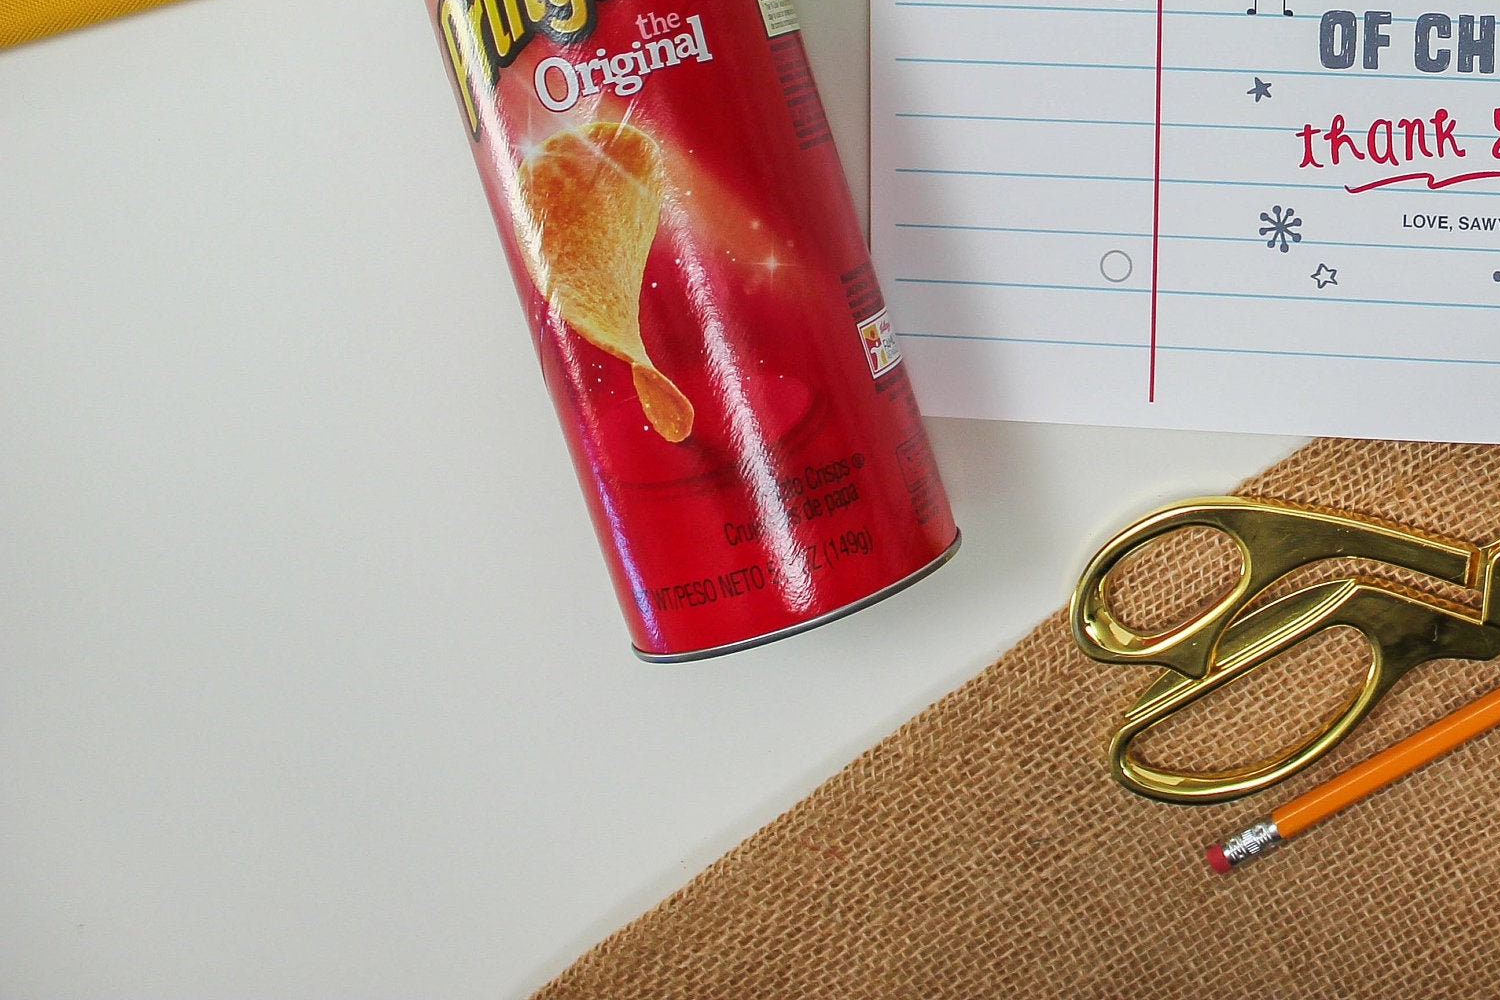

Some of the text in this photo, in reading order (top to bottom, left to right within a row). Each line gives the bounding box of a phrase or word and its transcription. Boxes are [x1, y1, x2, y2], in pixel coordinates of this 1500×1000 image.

[635, 11, 681, 40] the
[1319, 10, 1393, 71] OF
[534, 14, 713, 112] Original
[1295, 107, 1467, 169] thank
[1402, 214, 1453, 232] LOVE,
[804, 458, 850, 492] Crisps
[803, 498, 822, 521] de
[826, 482, 859, 514] papa
[718, 565, 766, 598] NETO
[823, 526, 874, 569] (149g)
